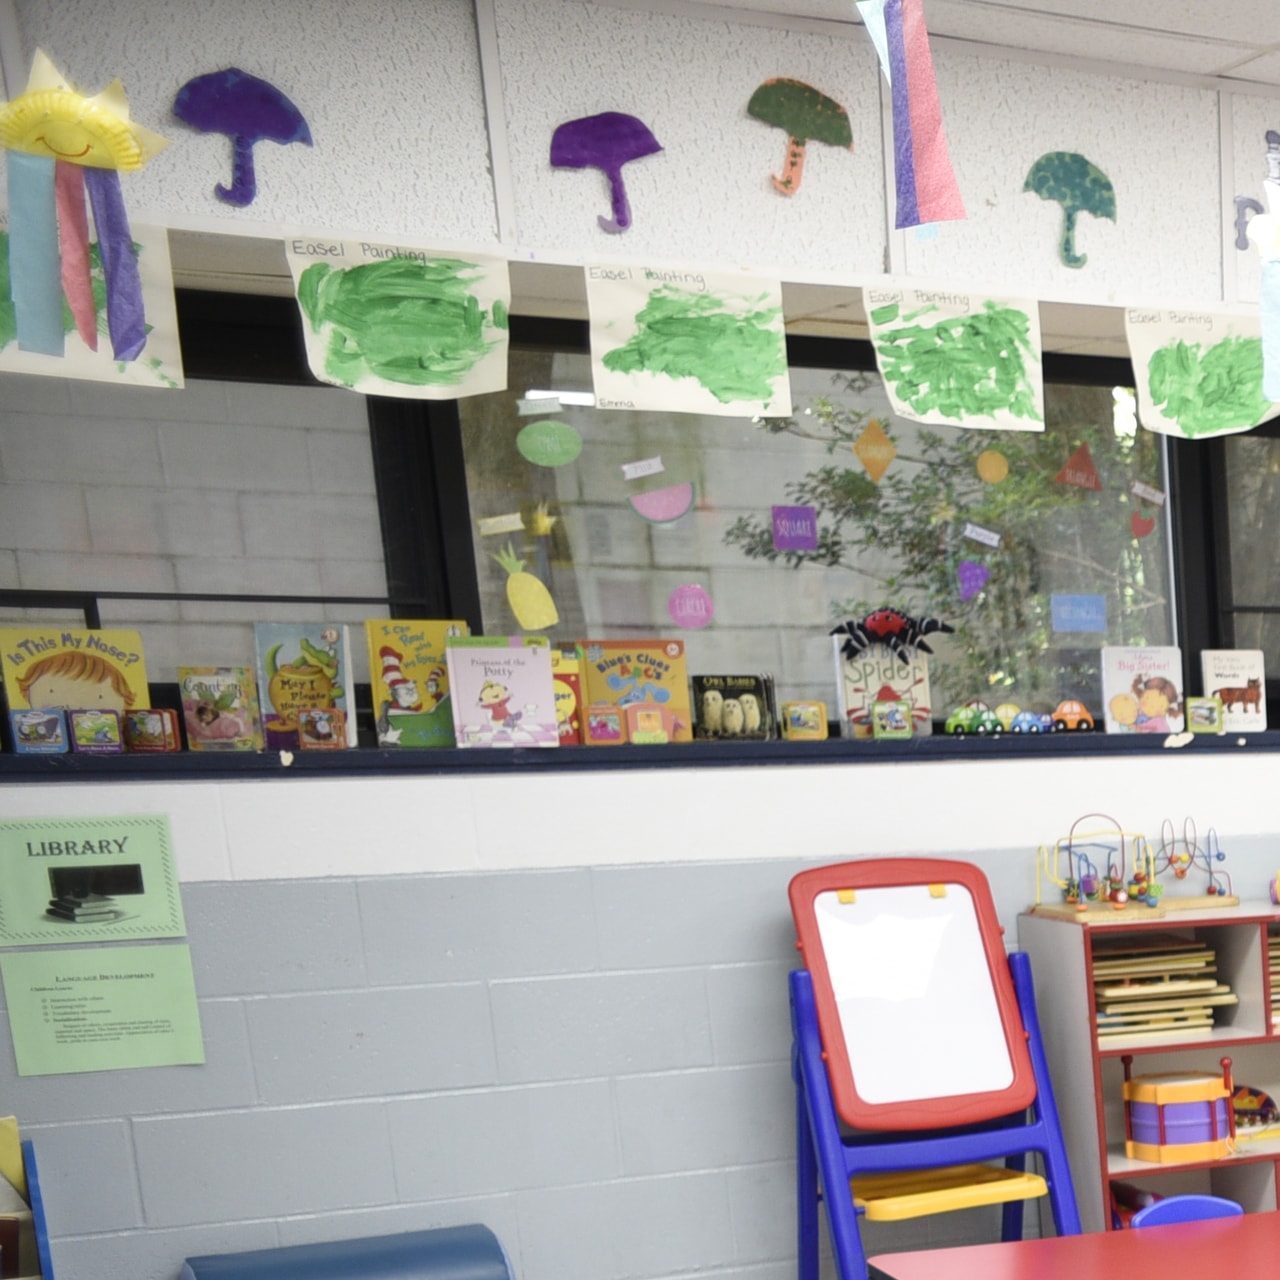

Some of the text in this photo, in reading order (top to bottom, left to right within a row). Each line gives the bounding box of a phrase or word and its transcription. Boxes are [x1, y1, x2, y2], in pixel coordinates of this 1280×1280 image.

[292, 239, 426, 266] Easel Painting
[588, 266, 706, 292] Easel Painting
[868, 290, 970, 314] Easel Painting
[1128, 309, 1213, 332] Easel Painting
[599, 398, 636, 408] Emma
[776, 519, 812, 539] SQUARE
[399, 632, 425, 646] Read
[7, 633, 139, 666] Is This My Nose?
[484, 665, 513, 678] Potty
[596, 653, 670, 673] Blue's Clues
[846, 656, 922, 689] Spider
[1118, 660, 1169, 671] Big Sister!
[183, 677, 242, 699] Counting
[280, 679, 316, 691] May I
[290, 692, 327, 700] Please
[26, 836, 129, 857] LIBRARY
